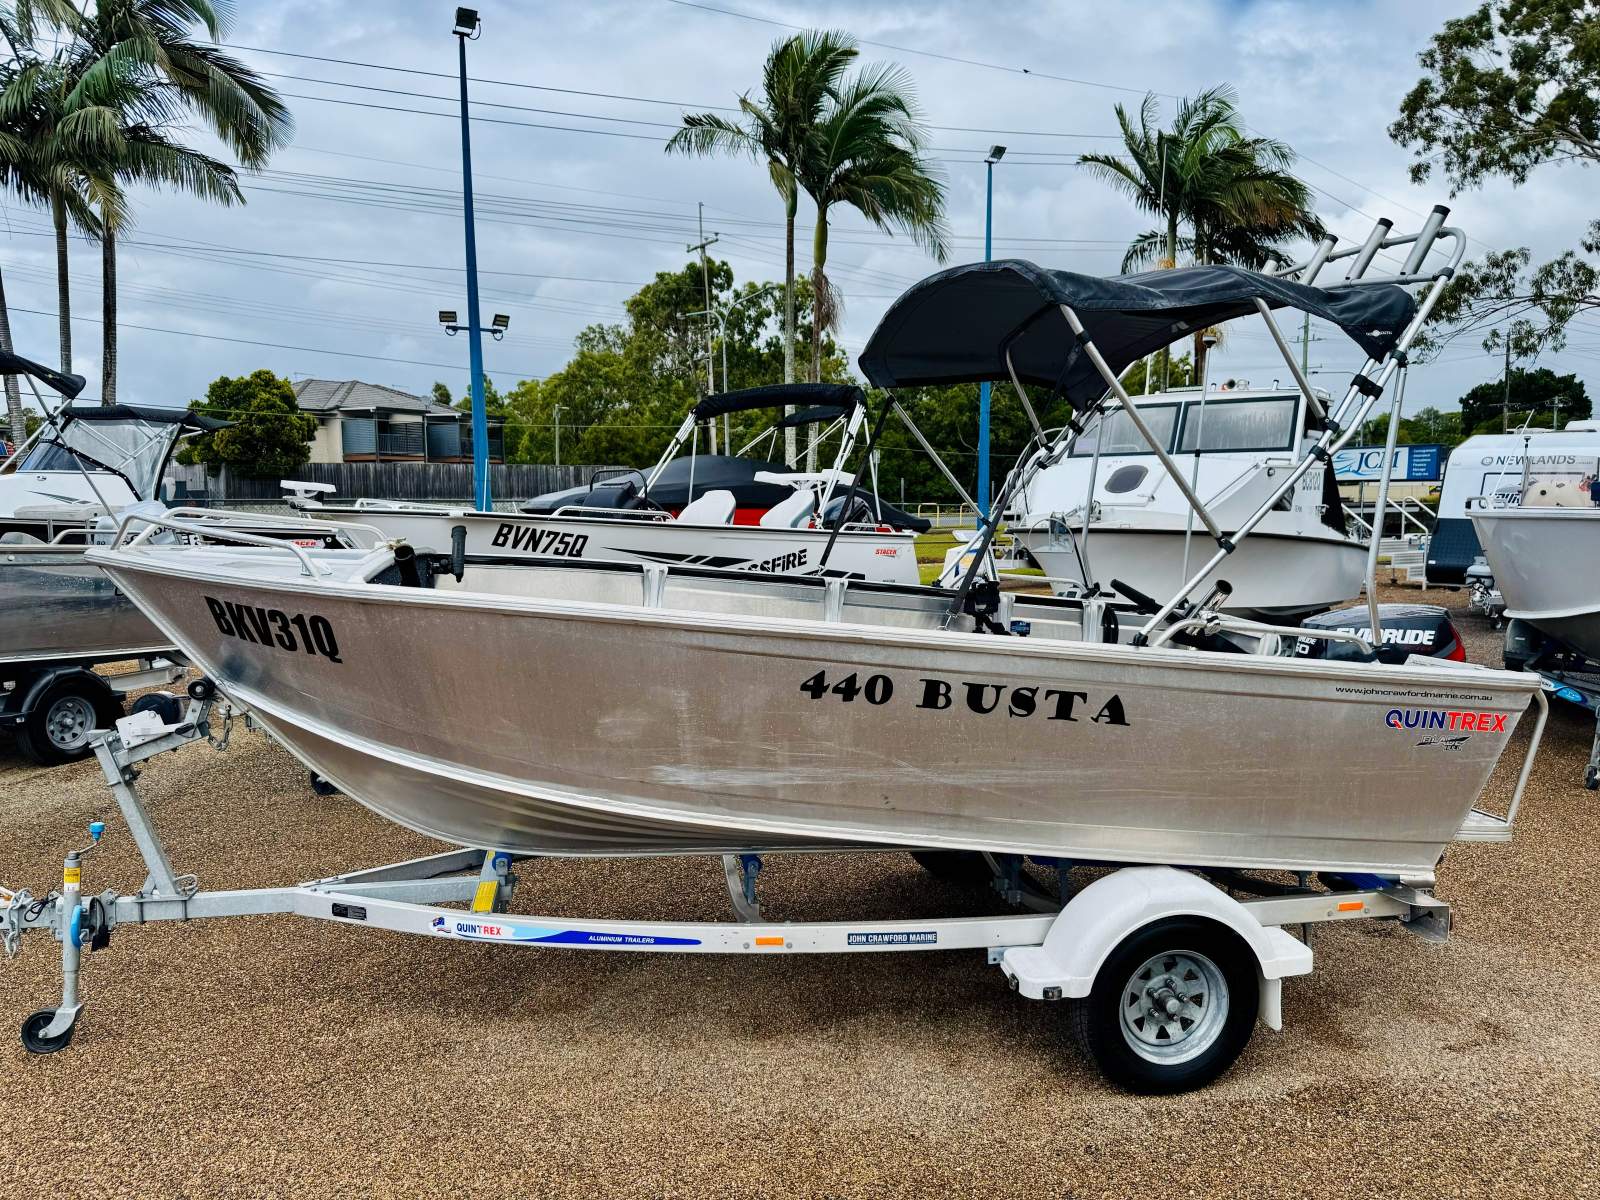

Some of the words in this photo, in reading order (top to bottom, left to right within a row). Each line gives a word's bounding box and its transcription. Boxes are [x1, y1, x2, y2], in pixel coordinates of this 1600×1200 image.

[1496, 455, 1576, 465] NEWLANDS
[492, 523, 589, 558] BVN75Q
[204, 595, 343, 664] BKV31Q
[800, 669, 894, 706] 440
[915, 678, 1131, 727] BUSTA
[1335, 686, 1493, 701] www.johncrawfordmarine.com.au
[1385, 709, 1508, 733] QUINTREX
[456, 922, 502, 936] QUINTREX
[588, 935, 622, 943] ALUMINIUM
[849, 934, 866, 943] JOHN
[868, 933, 908, 942] CRAWFORD
[909, 933, 937, 941] MARINE
